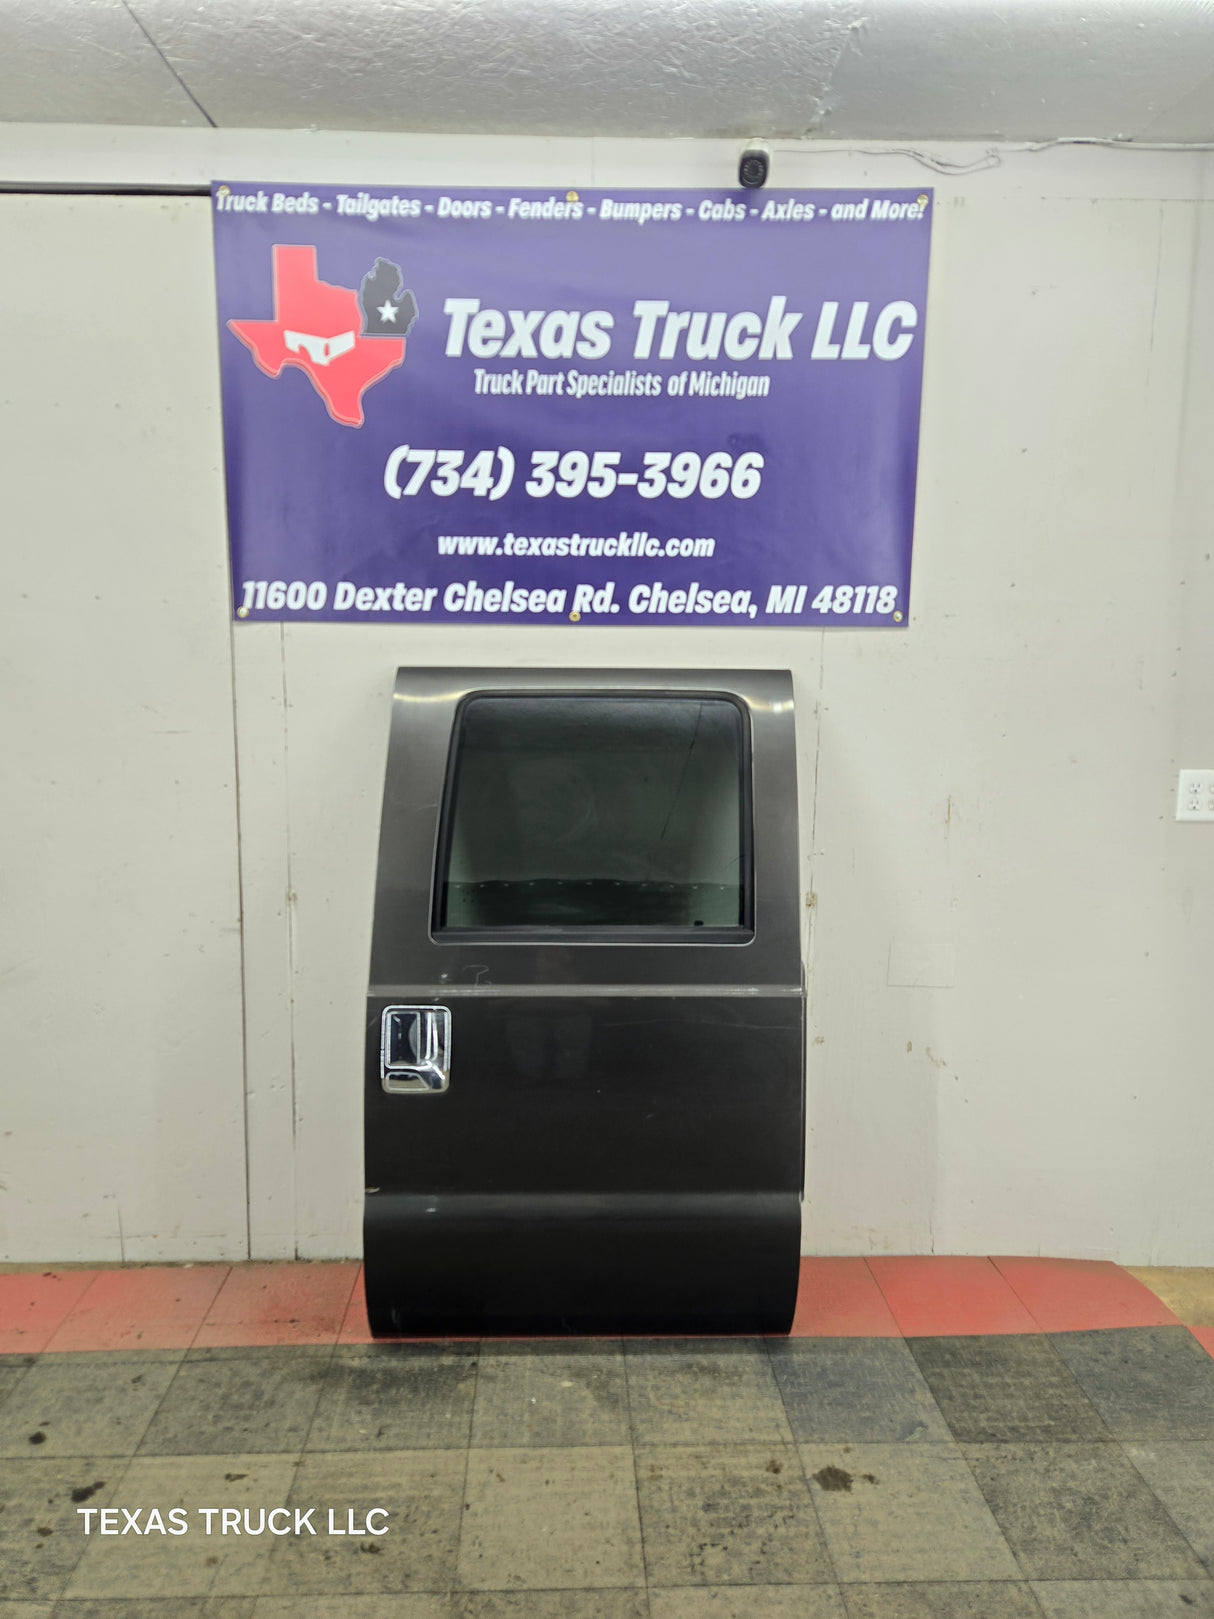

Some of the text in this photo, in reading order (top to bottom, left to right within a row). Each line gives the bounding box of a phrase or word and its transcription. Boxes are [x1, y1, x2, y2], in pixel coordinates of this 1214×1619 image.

[216, 191, 268, 212] Truck
[271, 192, 319, 213] Beds
[336, 192, 421, 221] Tailgates
[437, 196, 492, 219] Doors
[508, 196, 584, 219] Fenders
[599, 199, 683, 226] Bumpers
[699, 198, 747, 221] Cabs
[761, 198, 816, 221] Axles
[831, 198, 869, 220] and
[871, 199, 925, 220] More!
[444, 295, 918, 361] Texas Truck LLC
[474, 368, 770, 400] Truck Part Specialists of Michigan
[384, 444, 765, 501] (734) 395-3966
[437, 531, 716, 558] www.texastruckllc.com
[242, 580, 898, 619] 11600 Dexter Chelsea Rd. Chelsea, MI 48118
